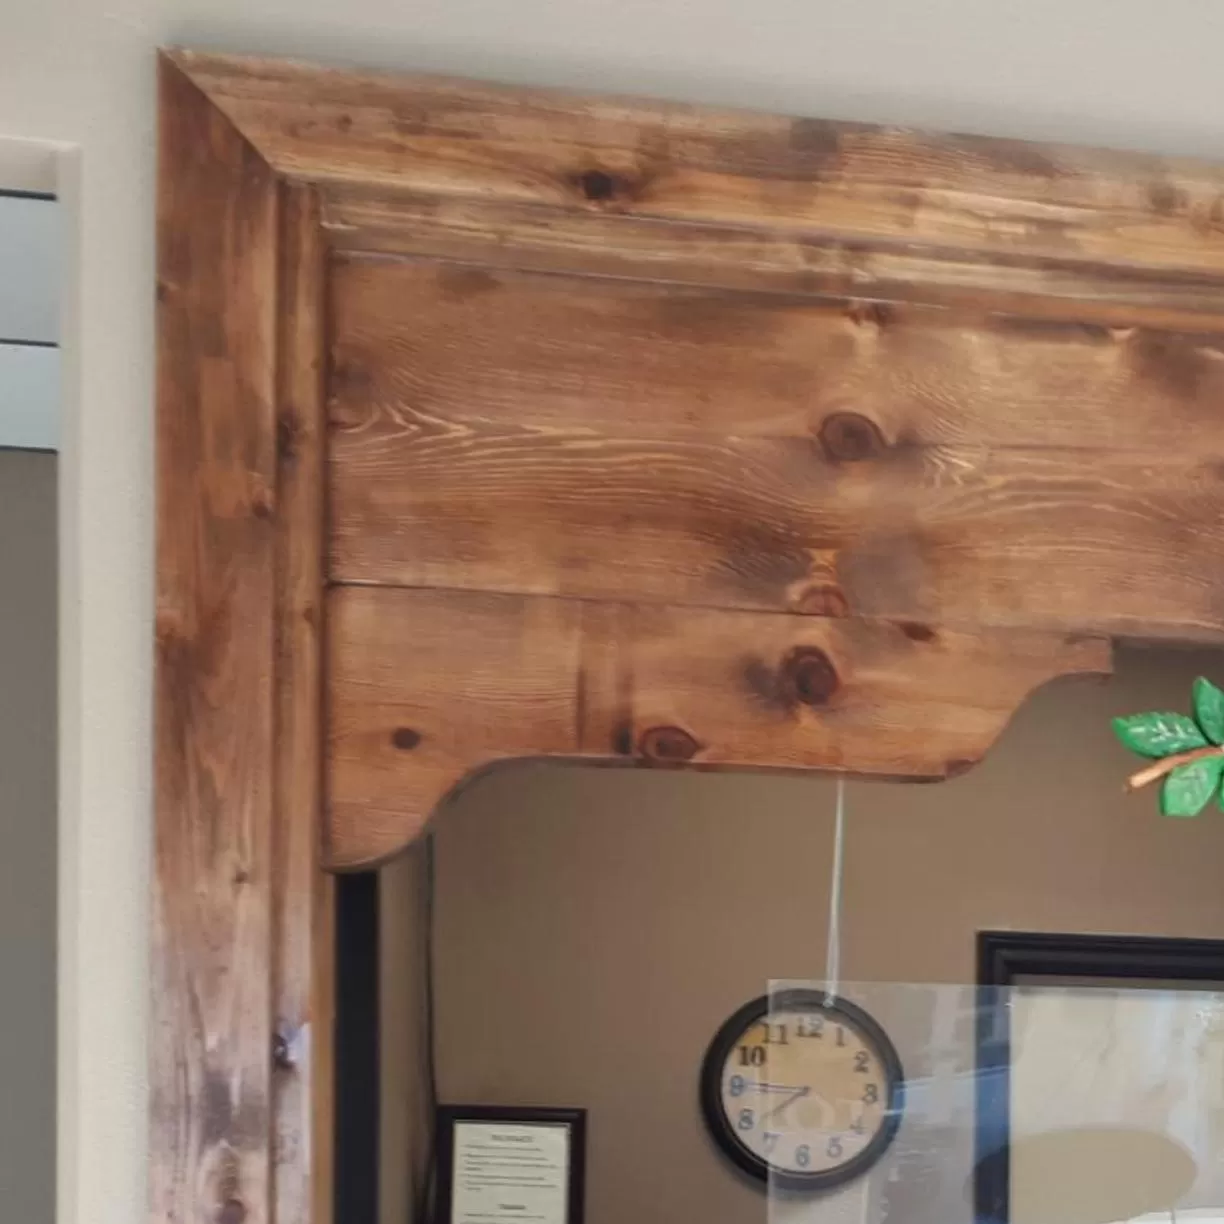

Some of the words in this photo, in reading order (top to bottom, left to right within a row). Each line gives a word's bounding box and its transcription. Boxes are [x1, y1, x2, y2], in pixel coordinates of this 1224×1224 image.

[763, 1023, 789, 1044] 11
[796, 1017, 823, 1038] 12
[834, 1027, 846, 1046] 1
[738, 1046, 765, 1066] 10
[854, 1051, 870, 1072] 2
[730, 1075, 745, 1096] 9
[862, 1084, 878, 1104] 3
[738, 1108, 754, 1130] 8
[763, 1132, 781, 1153] 7
[827, 1137, 843, 1157] 5
[795, 1144, 810, 1166] 6
